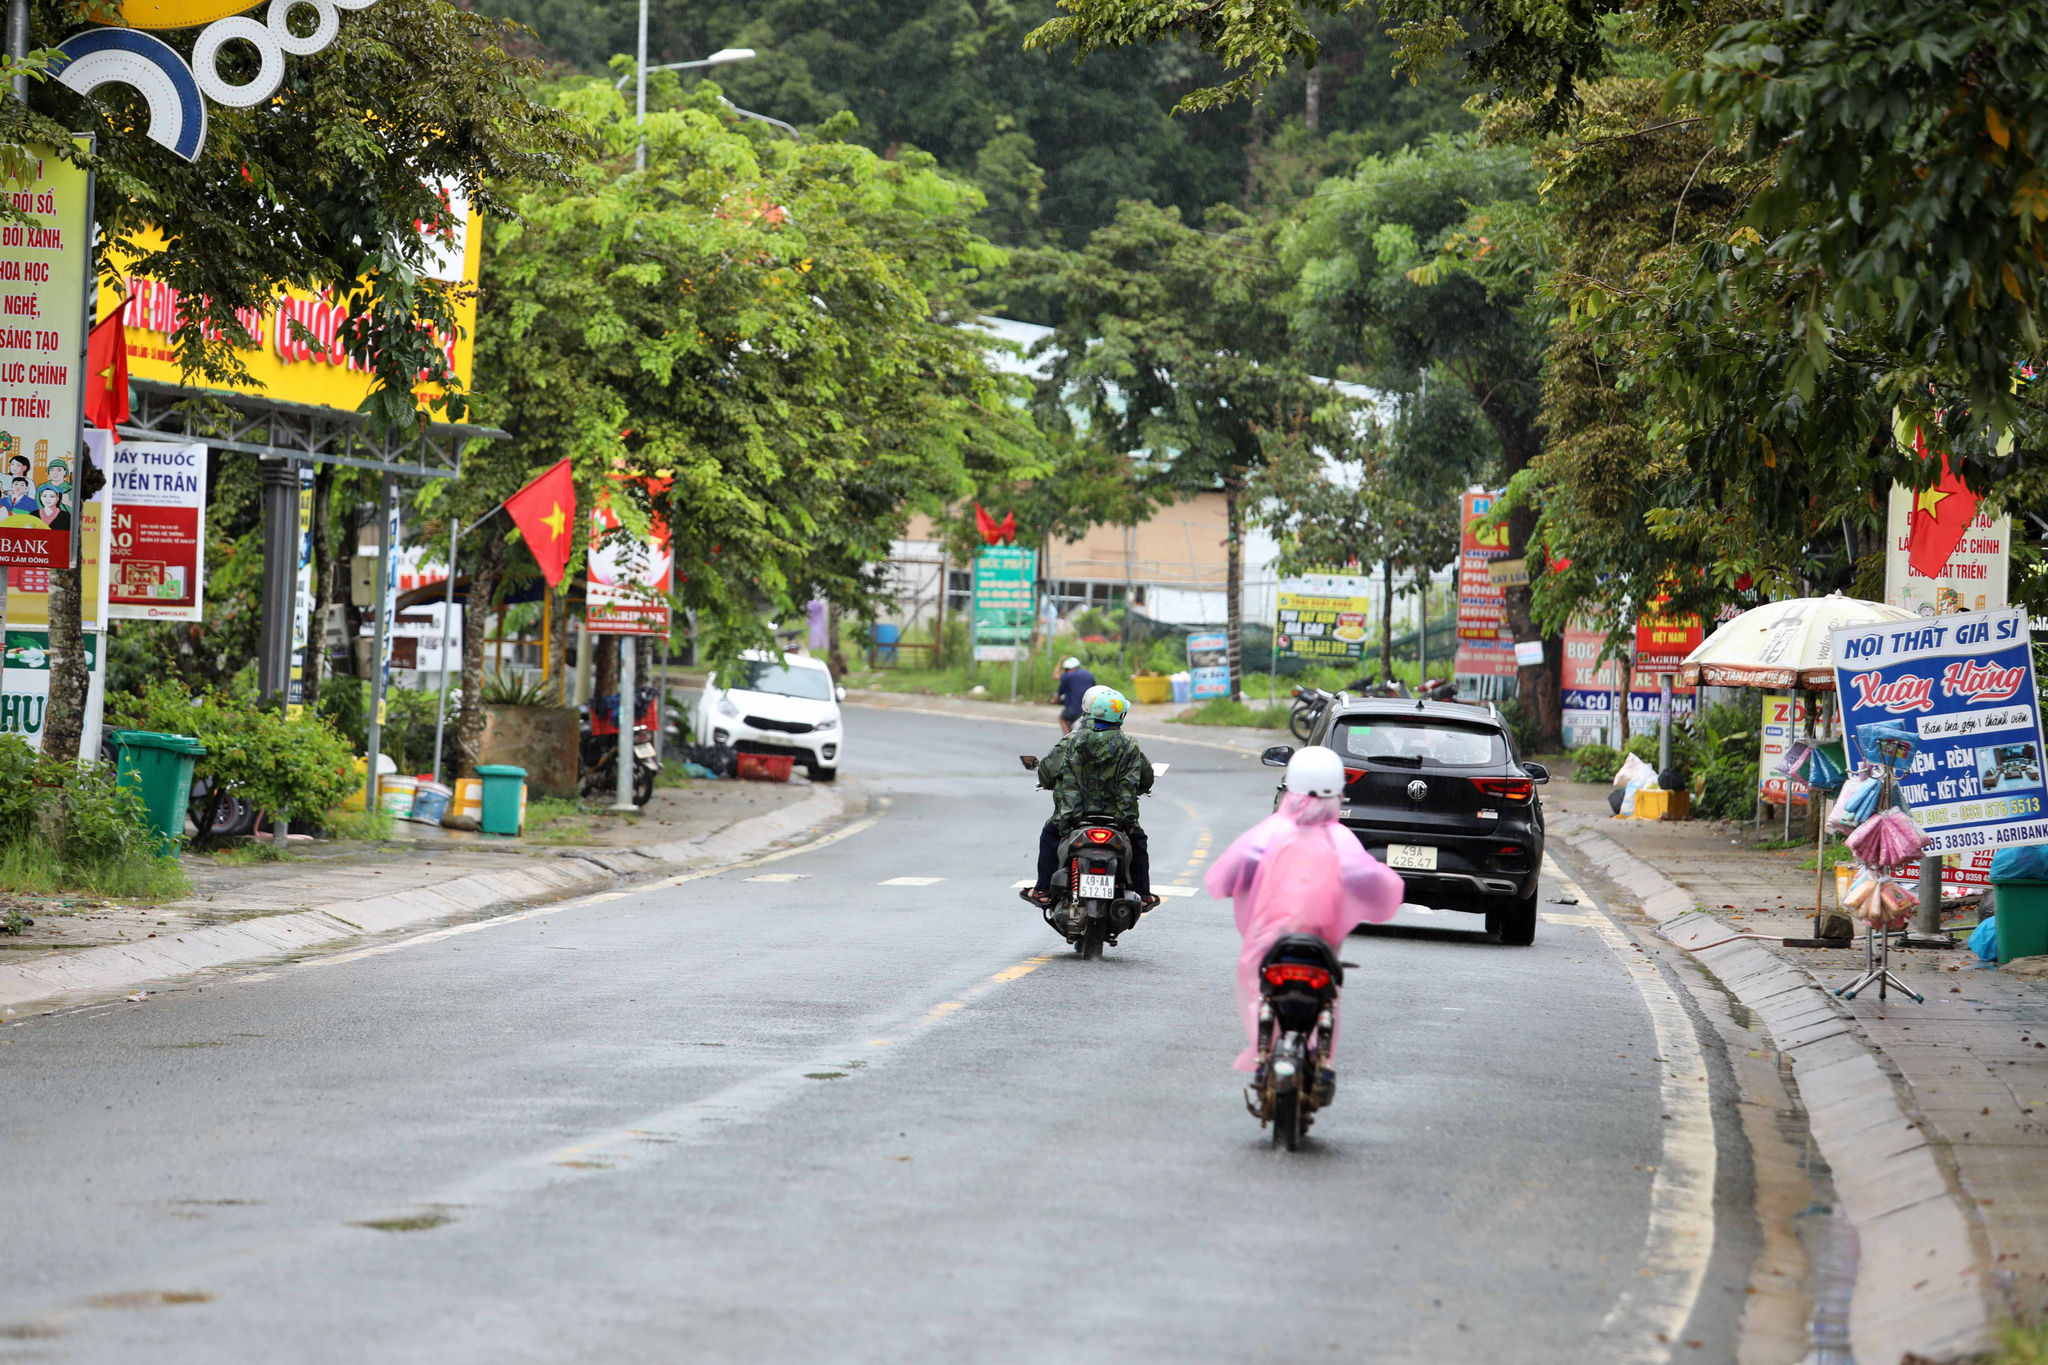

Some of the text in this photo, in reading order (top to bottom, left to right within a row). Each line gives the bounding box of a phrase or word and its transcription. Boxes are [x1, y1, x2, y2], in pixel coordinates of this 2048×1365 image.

[37, 187, 56, 216] SỐ,
[27, 227, 64, 251] XANH,
[24, 261, 49, 286] HỌC
[4, 292, 41, 320] NGHỆ,
[0, 324, 59, 355] SÁNG TẠO
[2, 361, 67, 387] LỰC CHÍNH
[11, 390, 51, 418] TRIỂN!
[142, 450, 196, 467] THUỐC
[153, 471, 197, 492] TRÂN
[1970, 535, 2000, 554] CHÍNH
[1956, 558, 1987, 580] TRIỂN!
[1844, 632, 1884, 661] NỘI
[1891, 619, 1949, 655] THẤT
[1955, 614, 1990, 646] GIÁ
[1567, 641, 1596, 664] BỌC
[1575, 666, 1594, 685] XE
[1586, 692, 1608, 711] CÓ
[1649, 696, 1693, 714] HNH
[1850, 670, 1935, 714] Xuân
[1945, 744, 1976, 769] RÈM
[1407, 779, 1428, 800] MG
[1937, 774, 1957, 801] KÉT
[1959, 769, 1980, 798] SẮT
[1926, 808, 1949, 824] 902
[1960, 805, 1983, 821] 033
[1985, 801, 2009, 818] 676
[2011, 798, 2041, 815] 5513
[1945, 832, 1986, 849] 383033
[1996, 822, 2048, 845] AGRIBANK
[1393, 856, 1432, 868] 426.47
[1401, 846, 1424, 858] 49A
[1085, 875, 1110, 886] 49-AA
[1965, 874, 1983, 883] 0359
